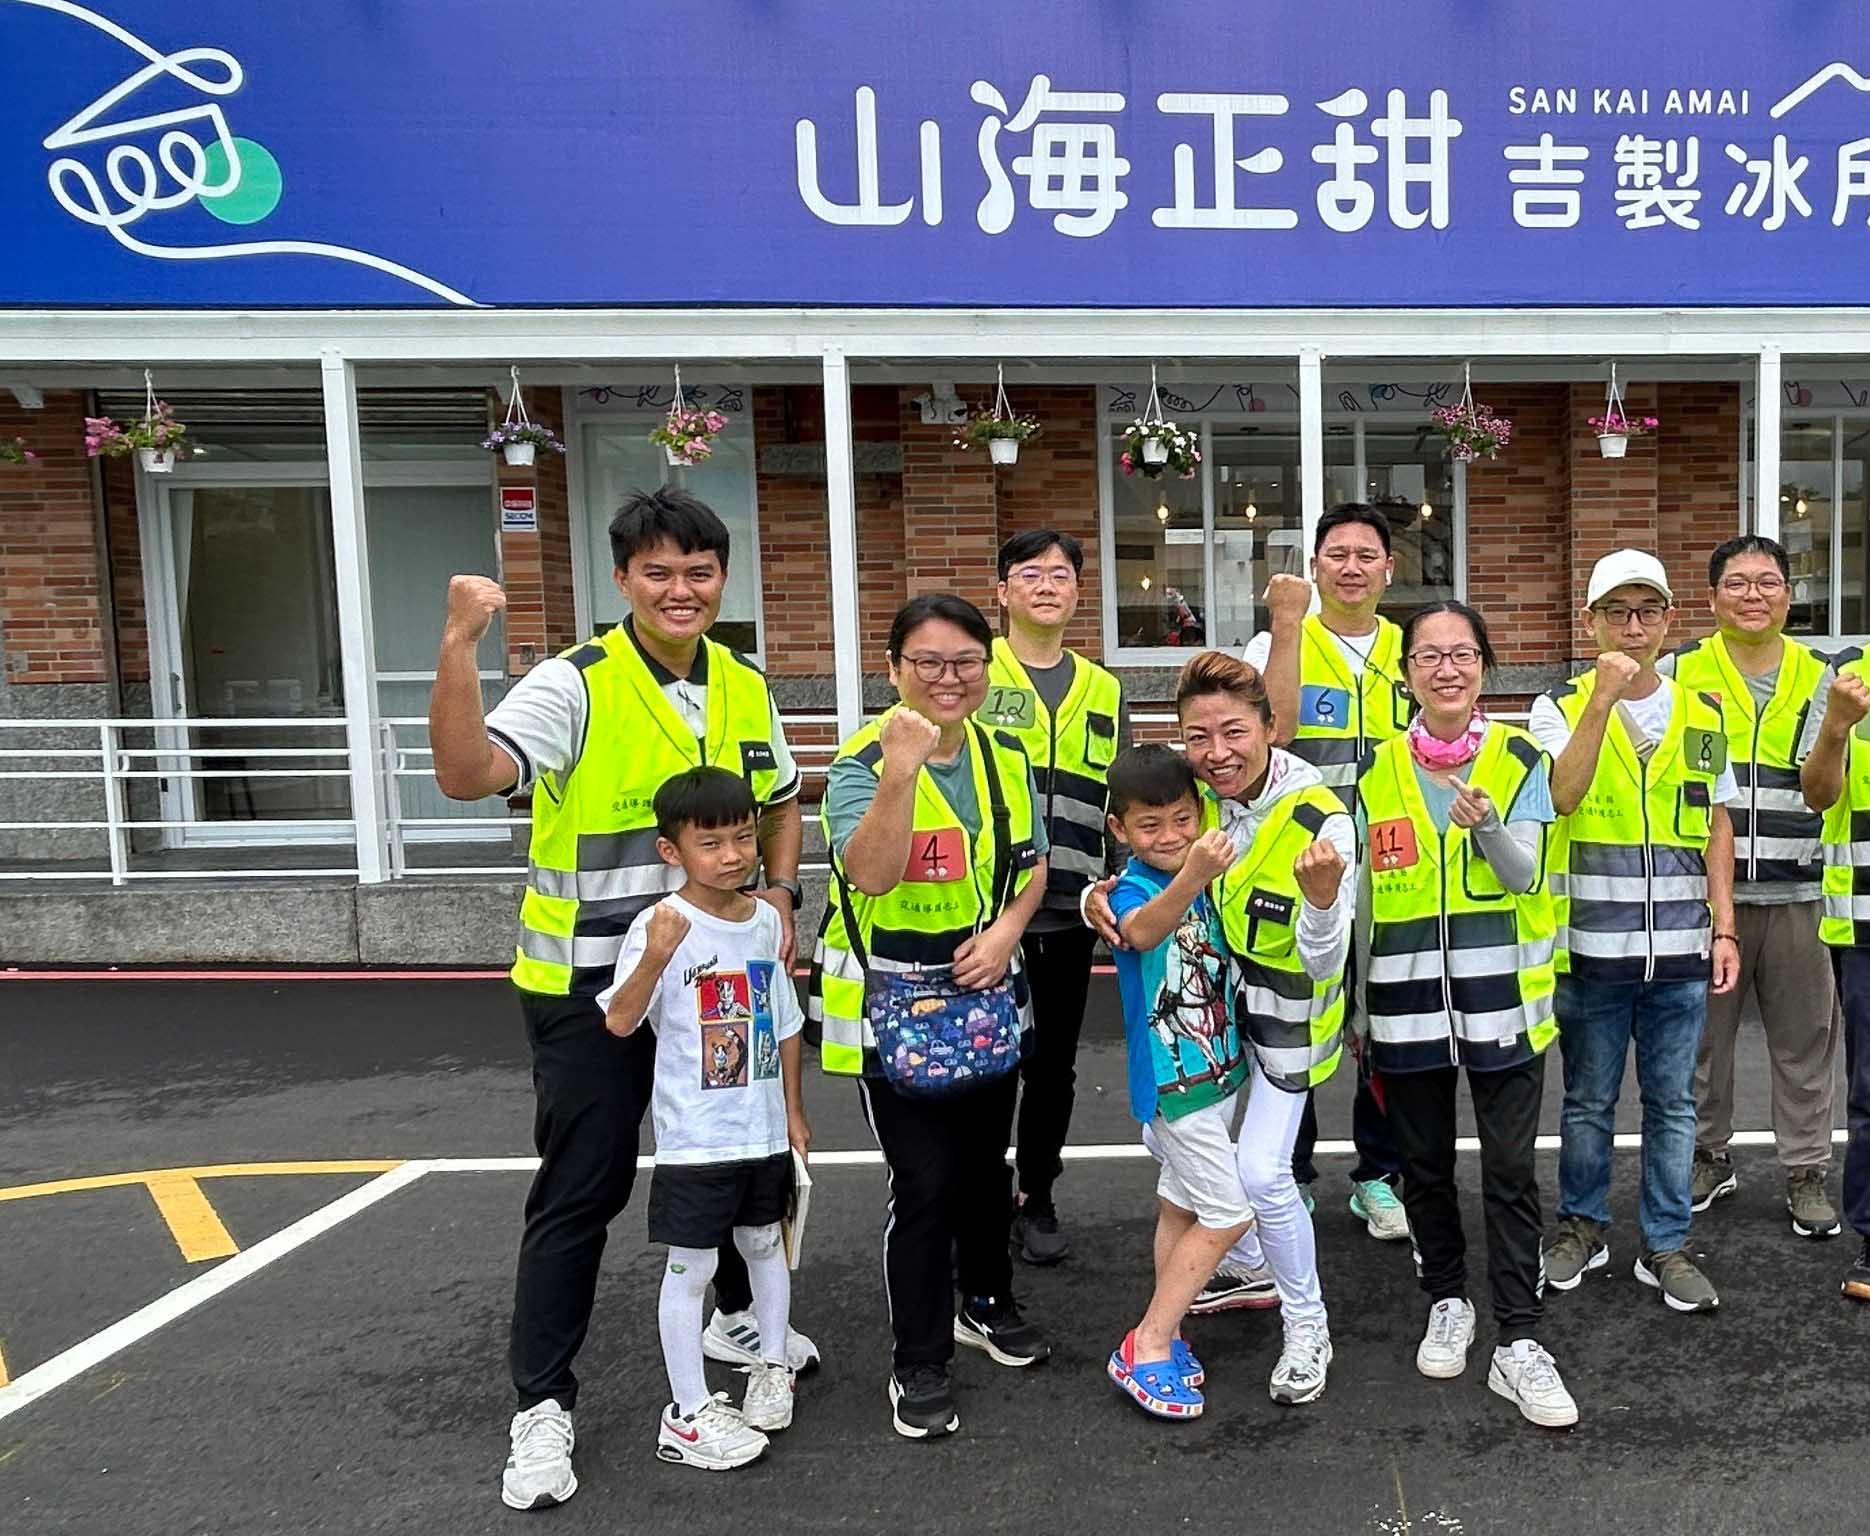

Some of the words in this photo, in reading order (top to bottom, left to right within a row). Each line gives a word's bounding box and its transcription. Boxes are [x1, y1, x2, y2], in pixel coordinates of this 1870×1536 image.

[1508, 86, 1577, 113] SAN
[1594, 88, 1648, 114] KAI
[1664, 89, 1749, 115] AMAI
[797, 74, 1463, 237] 山海正甜
[987, 689, 1026, 721] 12
[1316, 688, 1335, 715] 6
[1701, 733, 1713, 761] 8
[920, 834, 949, 870] 4
[1376, 825, 1404, 855] 11
